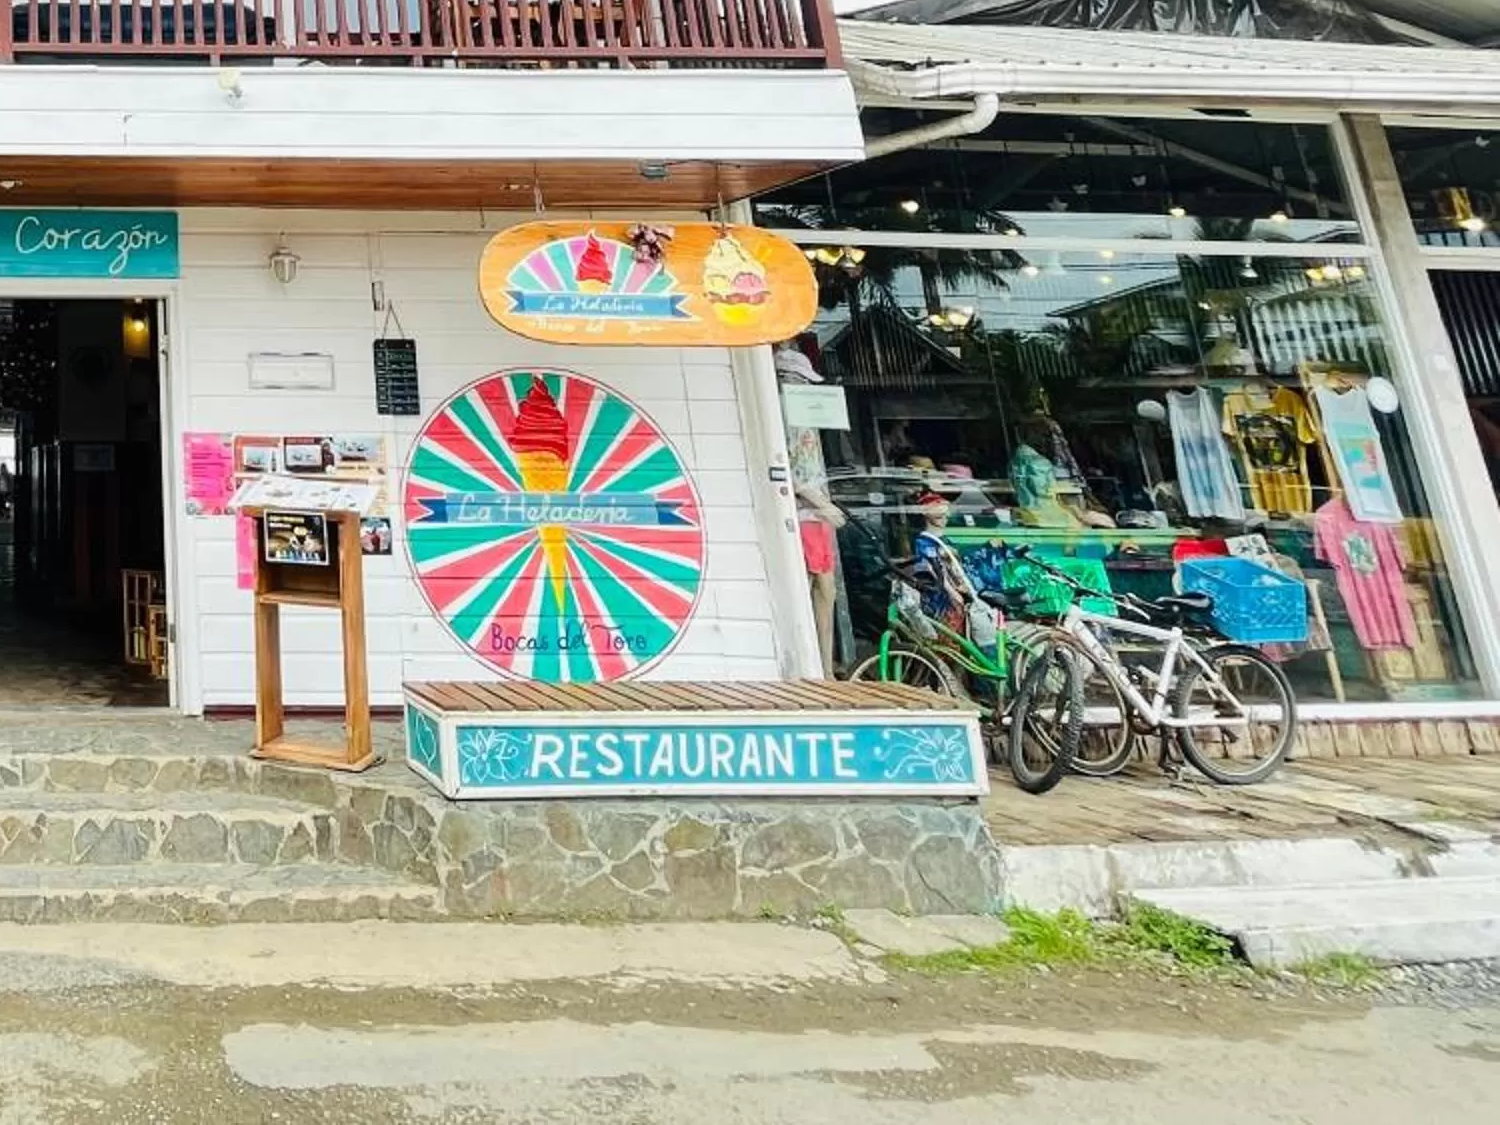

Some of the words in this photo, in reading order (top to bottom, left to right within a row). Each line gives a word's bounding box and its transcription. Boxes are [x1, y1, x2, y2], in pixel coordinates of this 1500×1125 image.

[15, 216, 168, 275] Corazón
[456, 493, 491, 521] La
[491, 622, 549, 651] Bocas
[557, 621, 590, 650] del
[592, 623, 647, 651] Toro
[529, 731, 858, 778] RESTAURANTE
